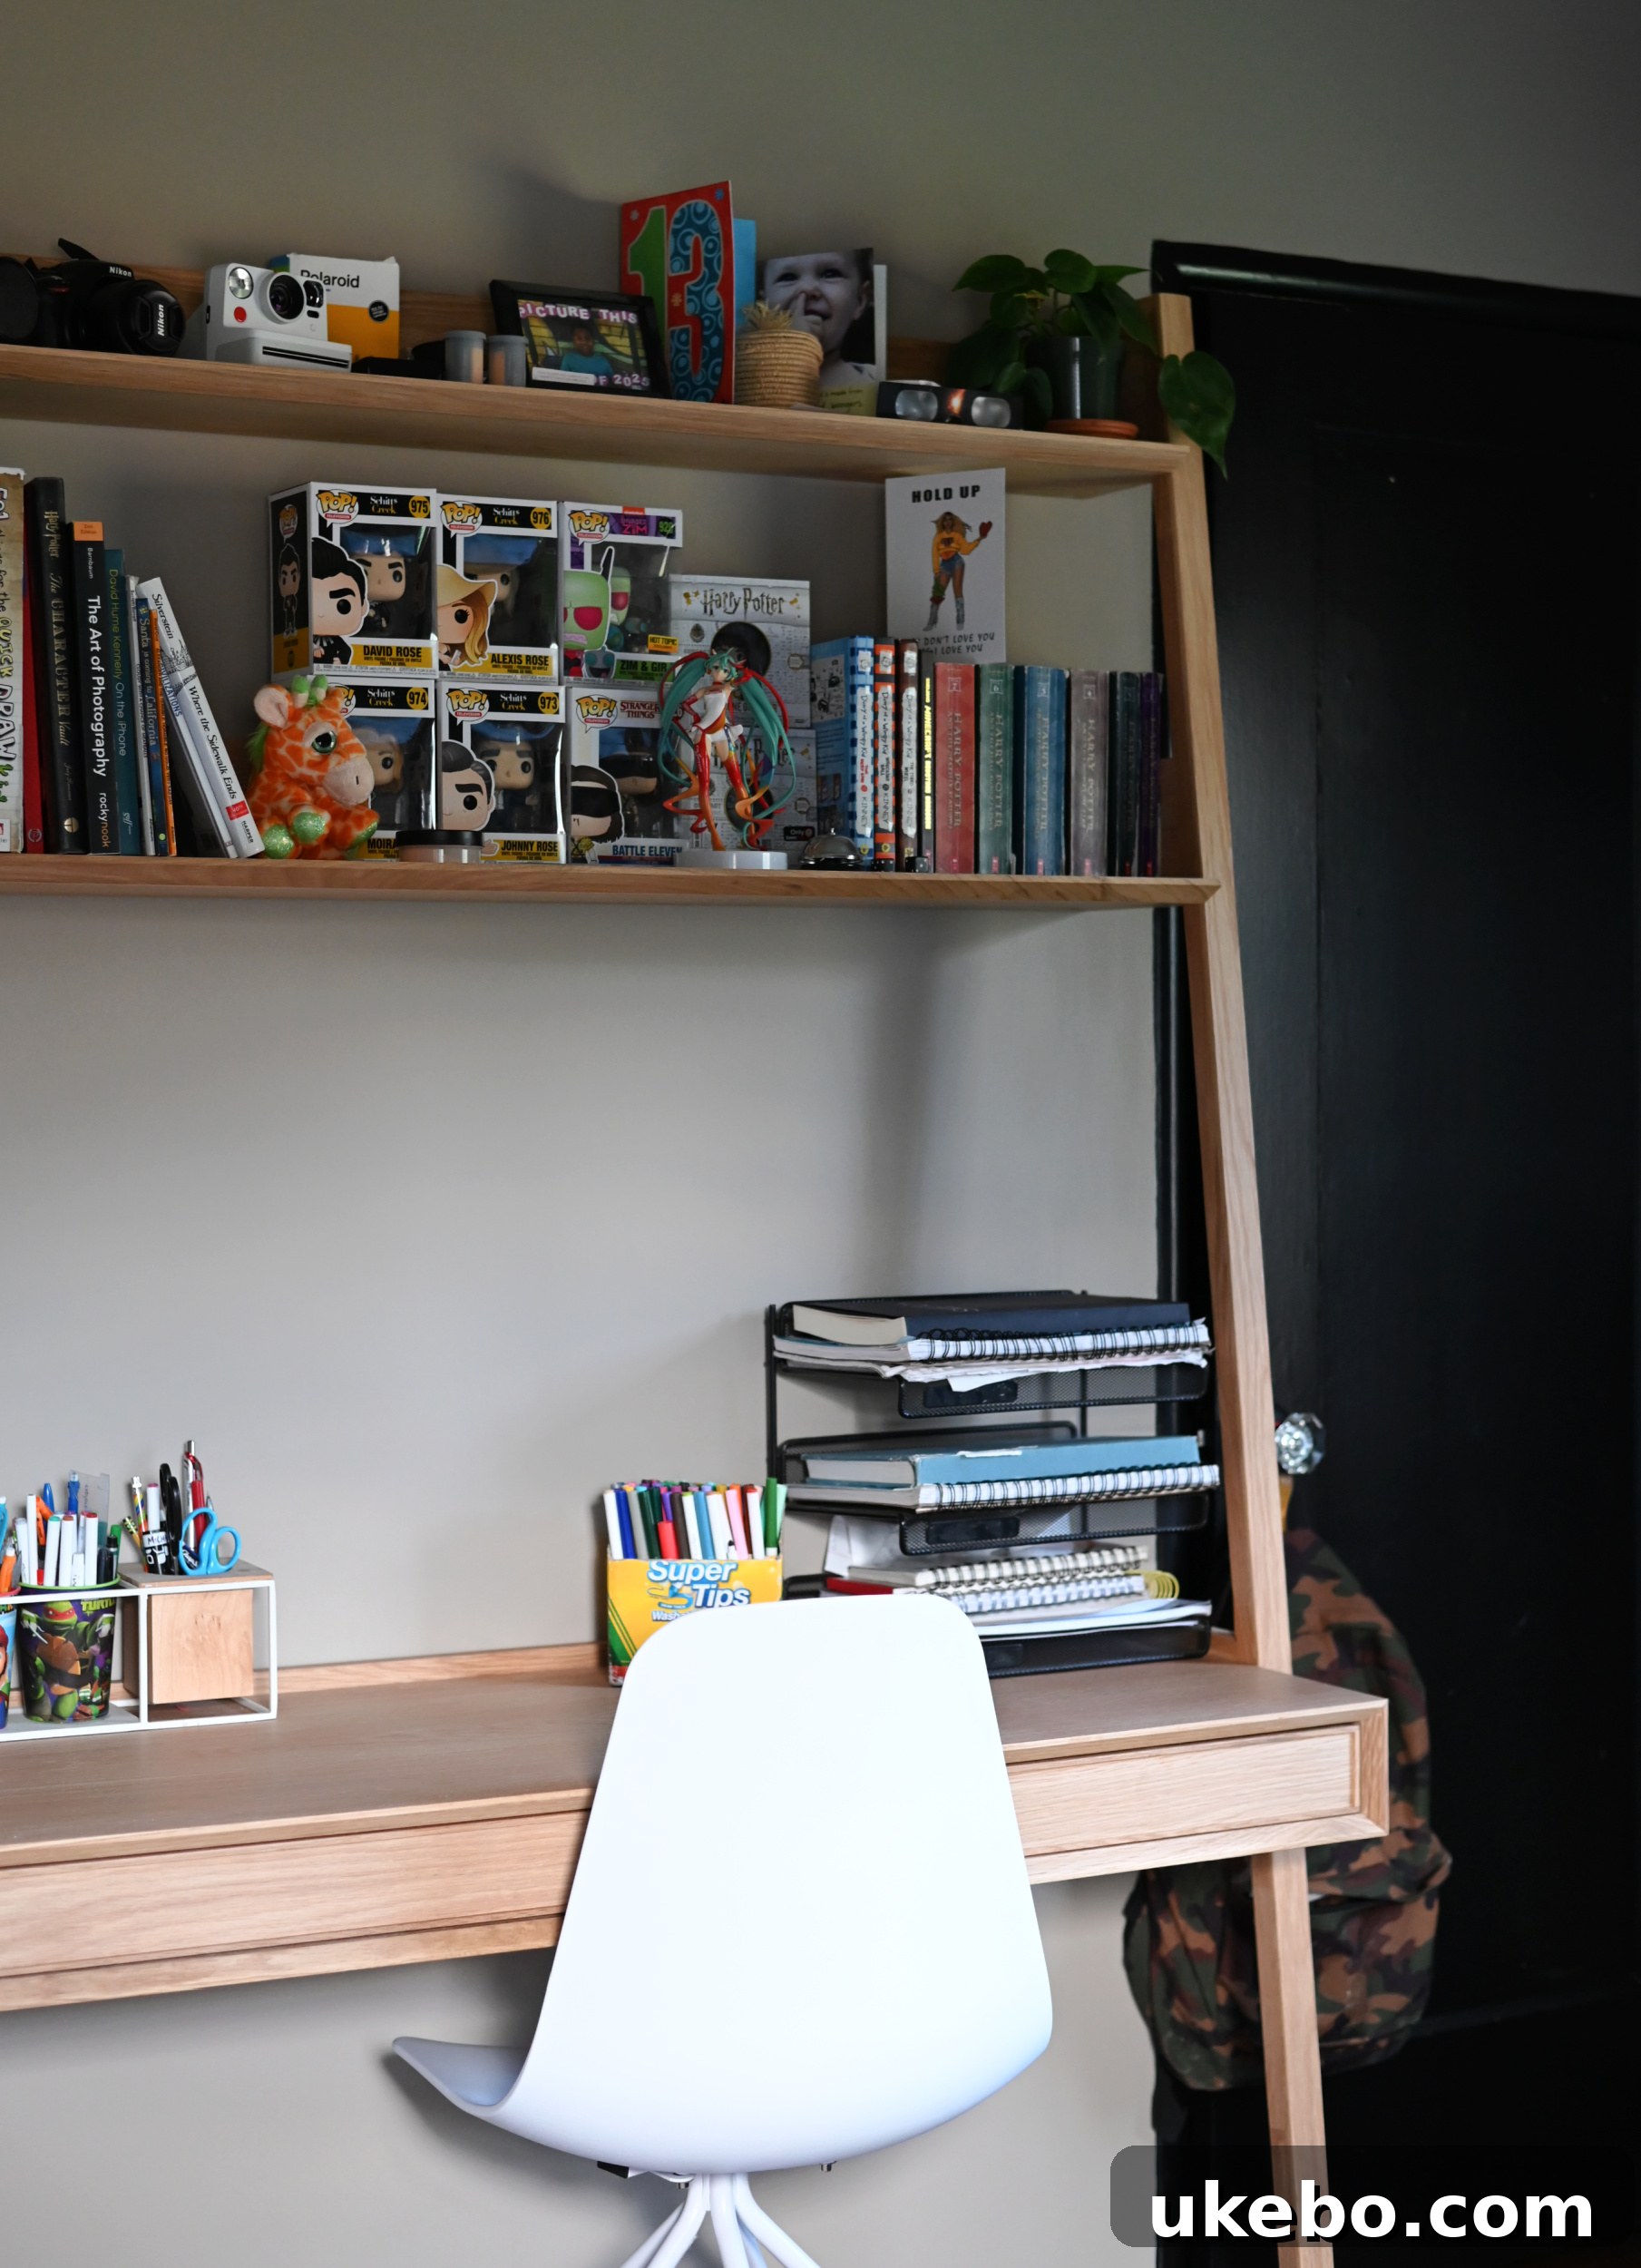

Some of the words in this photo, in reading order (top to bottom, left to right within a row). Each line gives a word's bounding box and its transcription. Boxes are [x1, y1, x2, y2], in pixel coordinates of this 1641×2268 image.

[109, 266, 132, 279] Nikon
[300, 269, 360, 288] Polaroid
[157, 304, 165, 337] Nikon
[600, 308, 638, 324] THIS
[316, 491, 357, 513] POP!
[912, 487, 953, 503] HOLD
[960, 484, 981, 499] UP
[411, 500, 428, 513] 975
[441, 503, 482, 525] POP!
[532, 512, 550, 525] 976
[569, 510, 609, 533] POP!
[109, 569, 119, 597] David
[88, 595, 102, 624] The
[700, 588, 741, 617] Harry
[743, 588, 786, 619] Potter
[111, 602, 120, 633] Hume
[152, 593, 174, 640] Silverstein
[89, 628, 103, 651] Art
[140, 618, 151, 648] Santa
[923, 635, 949, 646] DON'T
[952, 633, 974, 644] LOVE
[977, 631, 995, 641] YOU
[51, 600, 73, 717] CHARACTER
[111, 635, 122, 679] Kennerly
[363, 645, 393, 657] DAVID
[396, 646, 422, 658] ROSE
[491, 653, 523, 665] ALEXIS
[525, 655, 550, 667] ROSE
[943, 645, 962, 655] LOVE
[965, 643, 983, 653] YOU
[91, 655, 104, 673] of
[143, 660, 152, 684] coming
[620, 660, 639, 670] ZIM
[640, 661, 648, 671] &
[115, 682, 124, 699] On
[408, 691, 426, 705] 974
[445, 689, 488, 711] POP!
[880, 692, 889, 710] Diary
[115, 700, 125, 719] the
[540, 697, 558, 709] 973
[576, 696, 617, 718] POP!
[859, 695, 868, 713] Diary
[146, 696, 159, 746] California
[627, 710, 655, 719] THINGS
[91, 676, 110, 777] Photography
[858, 727, 869, 747] Wimpy
[880, 723, 890, 743] Wimpy
[923, 705, 932, 759] MINECRAFT
[116, 719, 127, 757] iPhone
[188, 685, 204, 717] Where
[198, 716, 210, 732] the
[206, 733, 228, 777] Sidewalk
[222, 776, 237, 799] Ends
[953, 712, 962, 766] HARRY
[994, 714, 1003, 767] HARRY
[1040, 717, 1050, 770] HARRY
[1088, 719, 1096, 772] HARRY
[860, 748, 869, 758] Kid
[882, 744, 890, 755] Kid
[906, 748, 914, 758] Kid
[953, 773, 962, 826] POTTER
[994, 774, 1003, 828] POTTER
[1040, 777, 1050, 830] POTTER
[1088, 777, 1096, 831] POTTER
[98, 792, 112, 847] rockynook
[860, 797, 868, 828] KINNEY
[241, 820, 254, 843] HARPER
[502, 840, 534, 851] JOHNNY
[536, 841, 558, 852] ROSE
[612, 845, 646, 856] BATTLE
[647, 1560, 737, 1586] Super
[81, 1598, 116, 1613] TURTL
[690, 1582, 751, 1608] Tips
